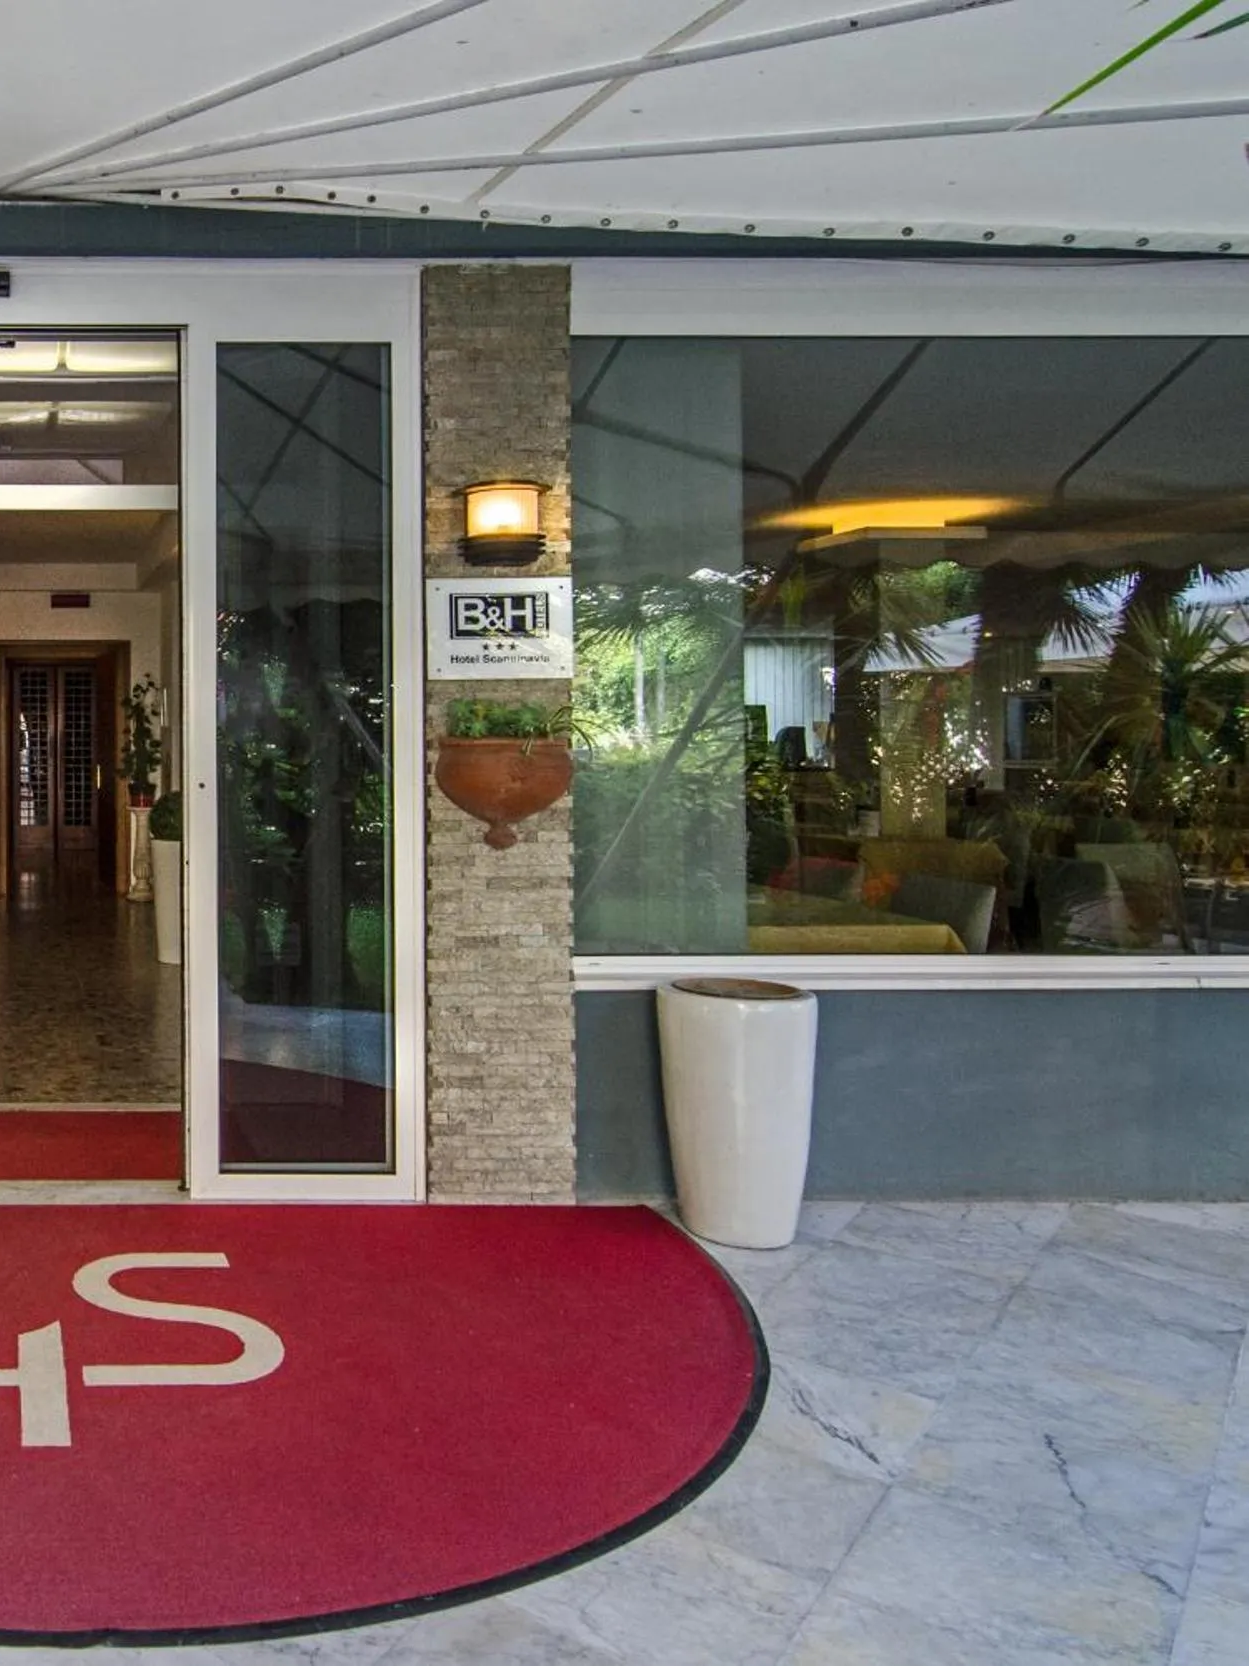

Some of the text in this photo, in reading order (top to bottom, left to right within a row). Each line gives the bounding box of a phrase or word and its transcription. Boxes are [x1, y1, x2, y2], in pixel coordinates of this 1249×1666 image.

[457, 597, 534, 632] B&H
[535, 592, 546, 638] OTELS
[450, 654, 480, 664] Hotel
